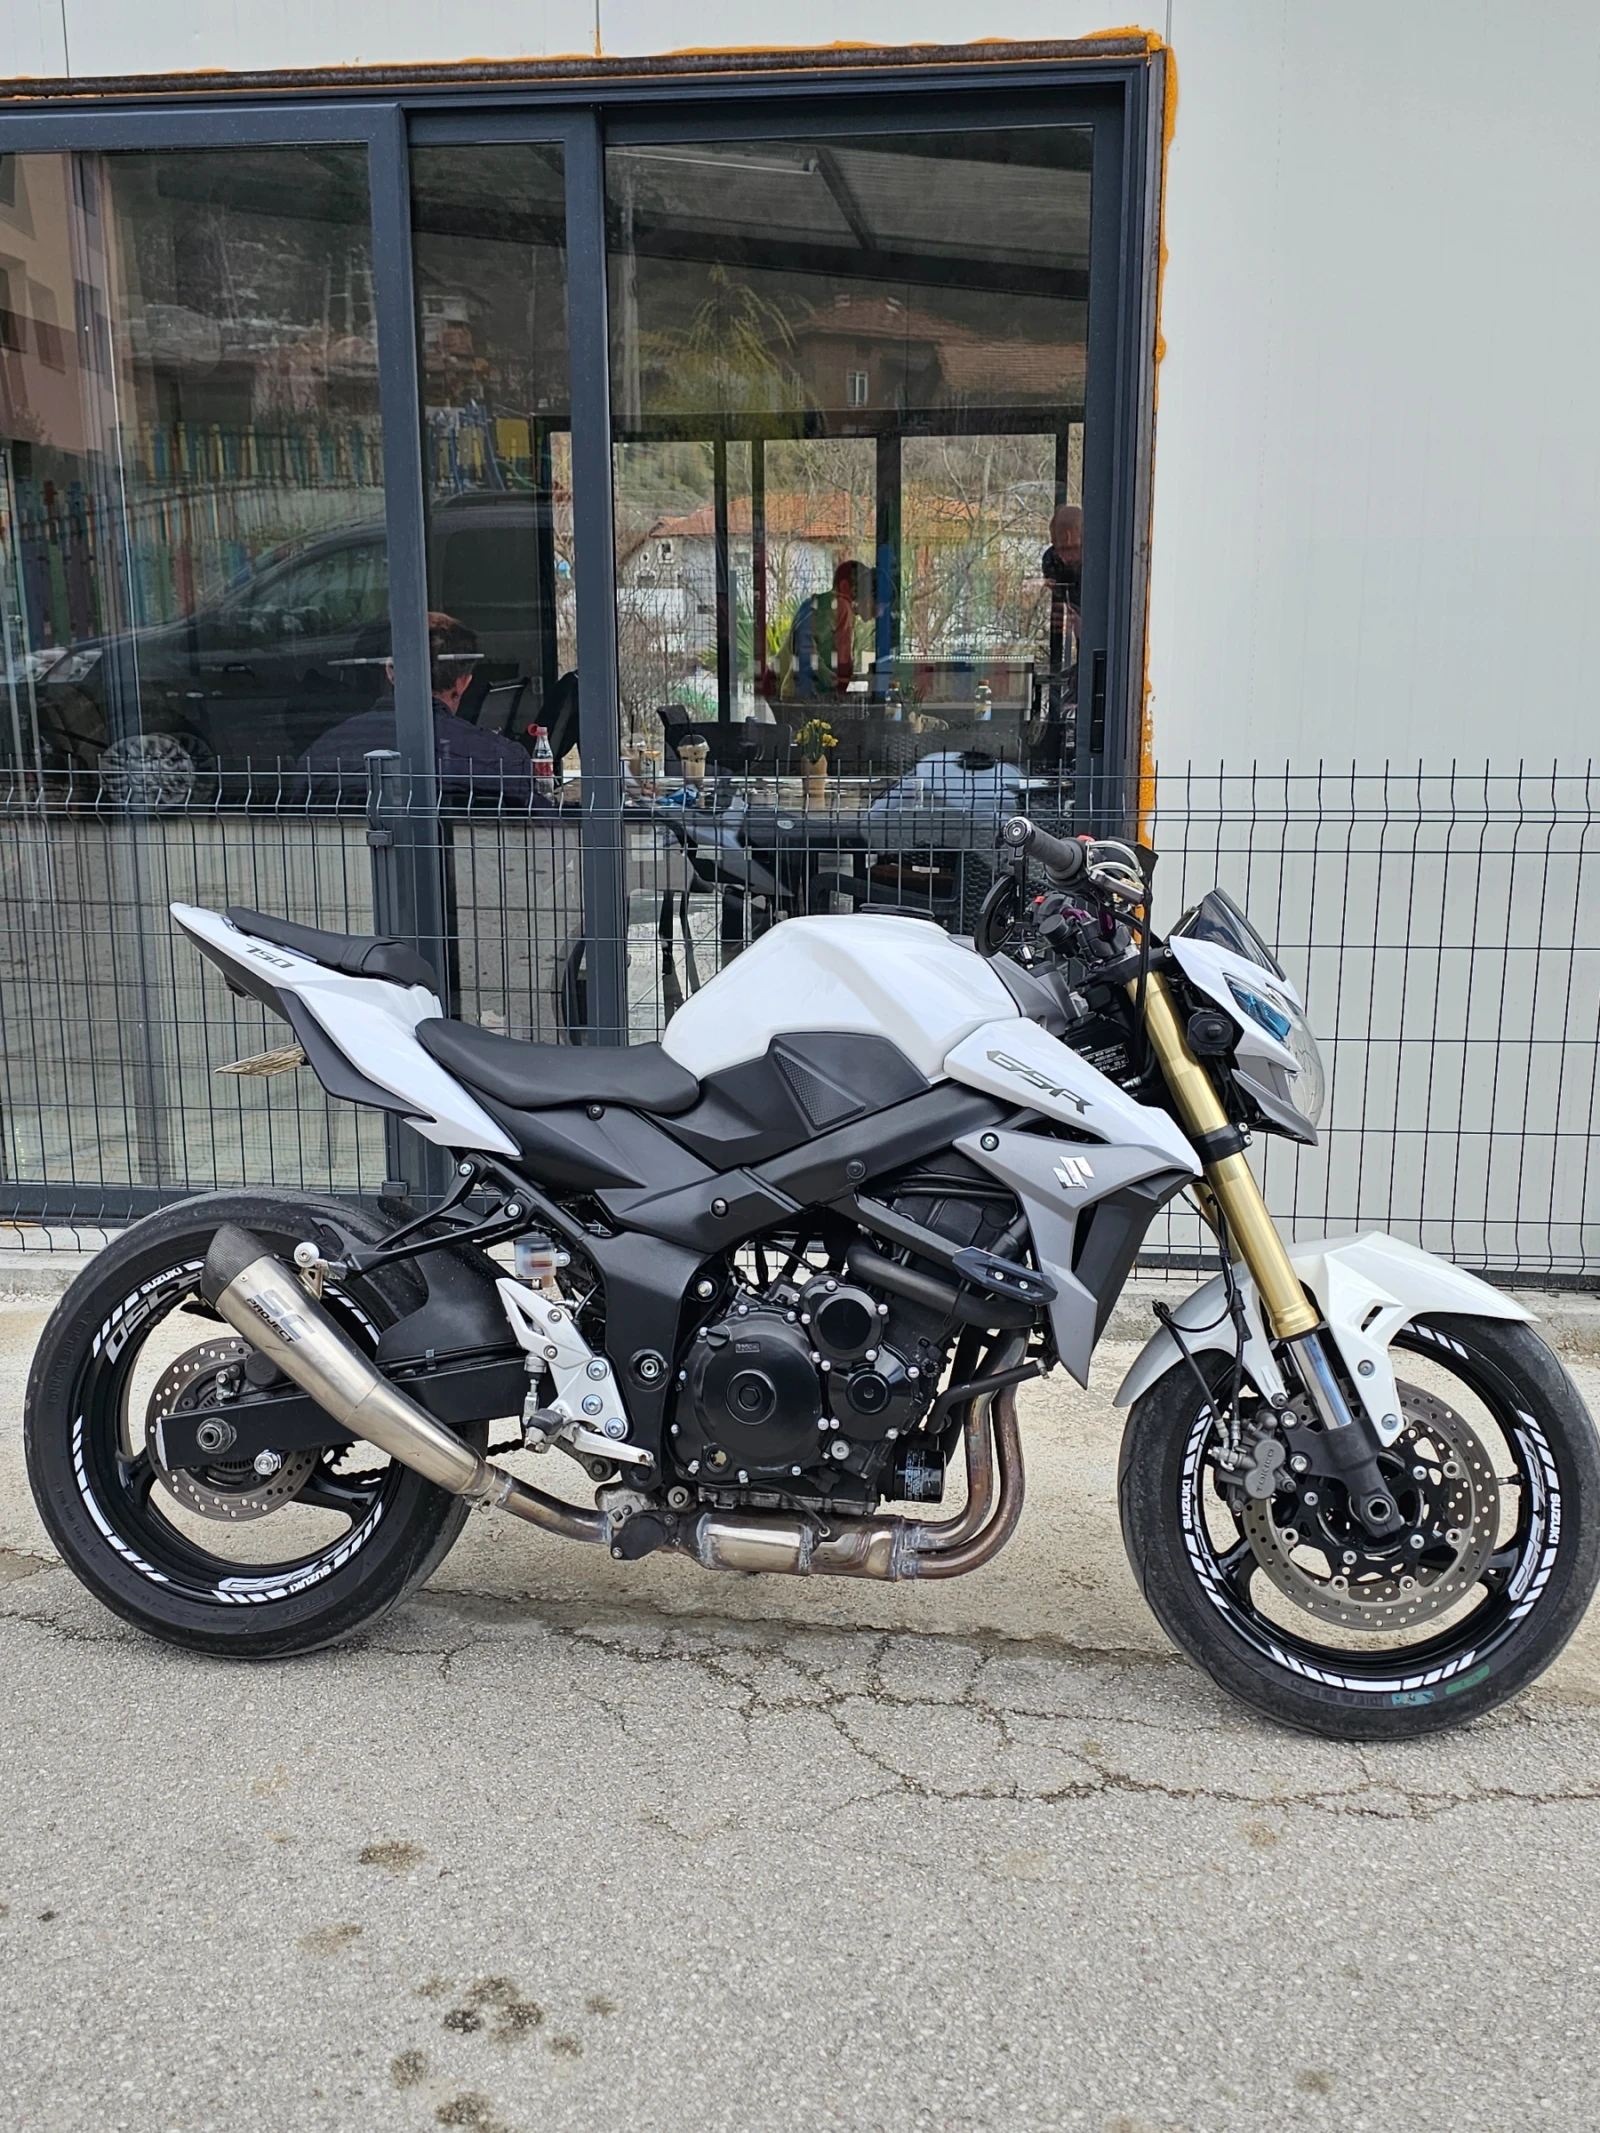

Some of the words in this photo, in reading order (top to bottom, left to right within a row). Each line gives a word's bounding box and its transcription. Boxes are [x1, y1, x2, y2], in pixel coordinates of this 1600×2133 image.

[245, 943, 295, 969] 750
[986, 1050, 1094, 1115] GSR
[140, 1266, 183, 1295] SUZUKI
[246, 1298, 296, 1344] PROJECT
[254, 1288, 316, 1341] SC
[1181, 1479, 1193, 1530] SUZUKI
[1548, 1492, 1562, 1545] SUZUKI
[288, 1563, 332, 1594] SUZUKI
